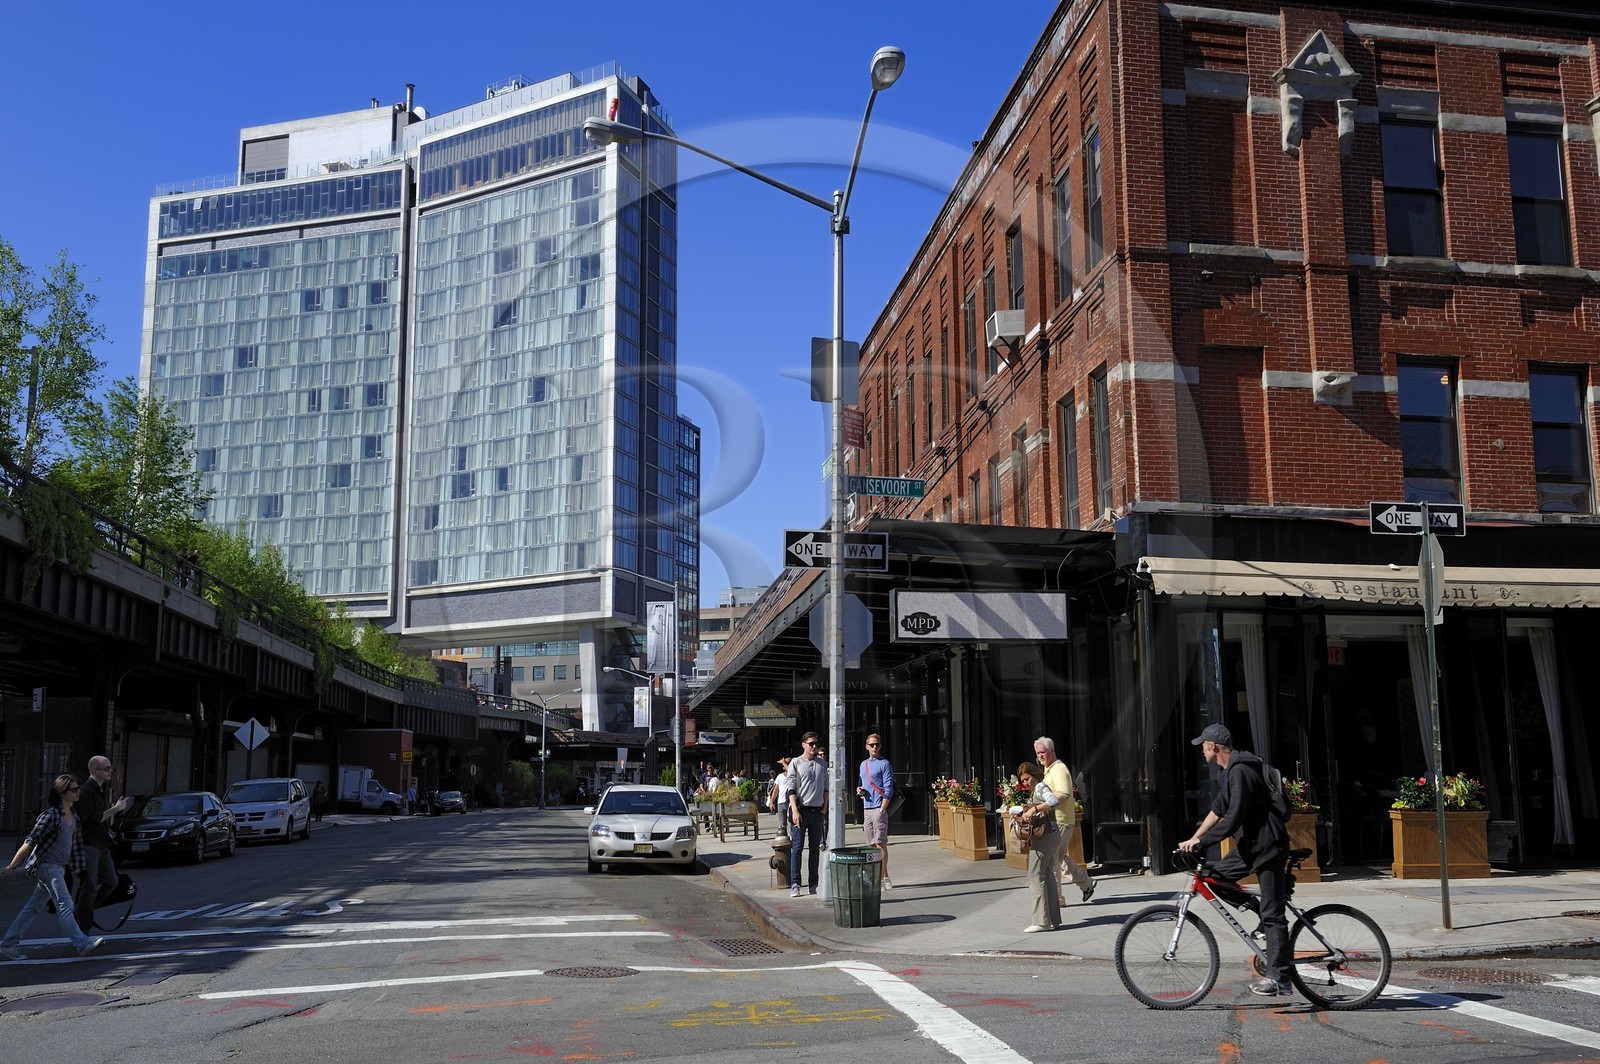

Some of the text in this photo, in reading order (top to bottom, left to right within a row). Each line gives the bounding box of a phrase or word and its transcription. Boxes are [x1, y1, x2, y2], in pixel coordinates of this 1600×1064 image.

[849, 477, 921, 495] GANSEVOORT ST
[1385, 513, 1412, 525] ONE
[794, 543, 877, 557] ONE WAY
[907, 617, 936, 629] MPD
